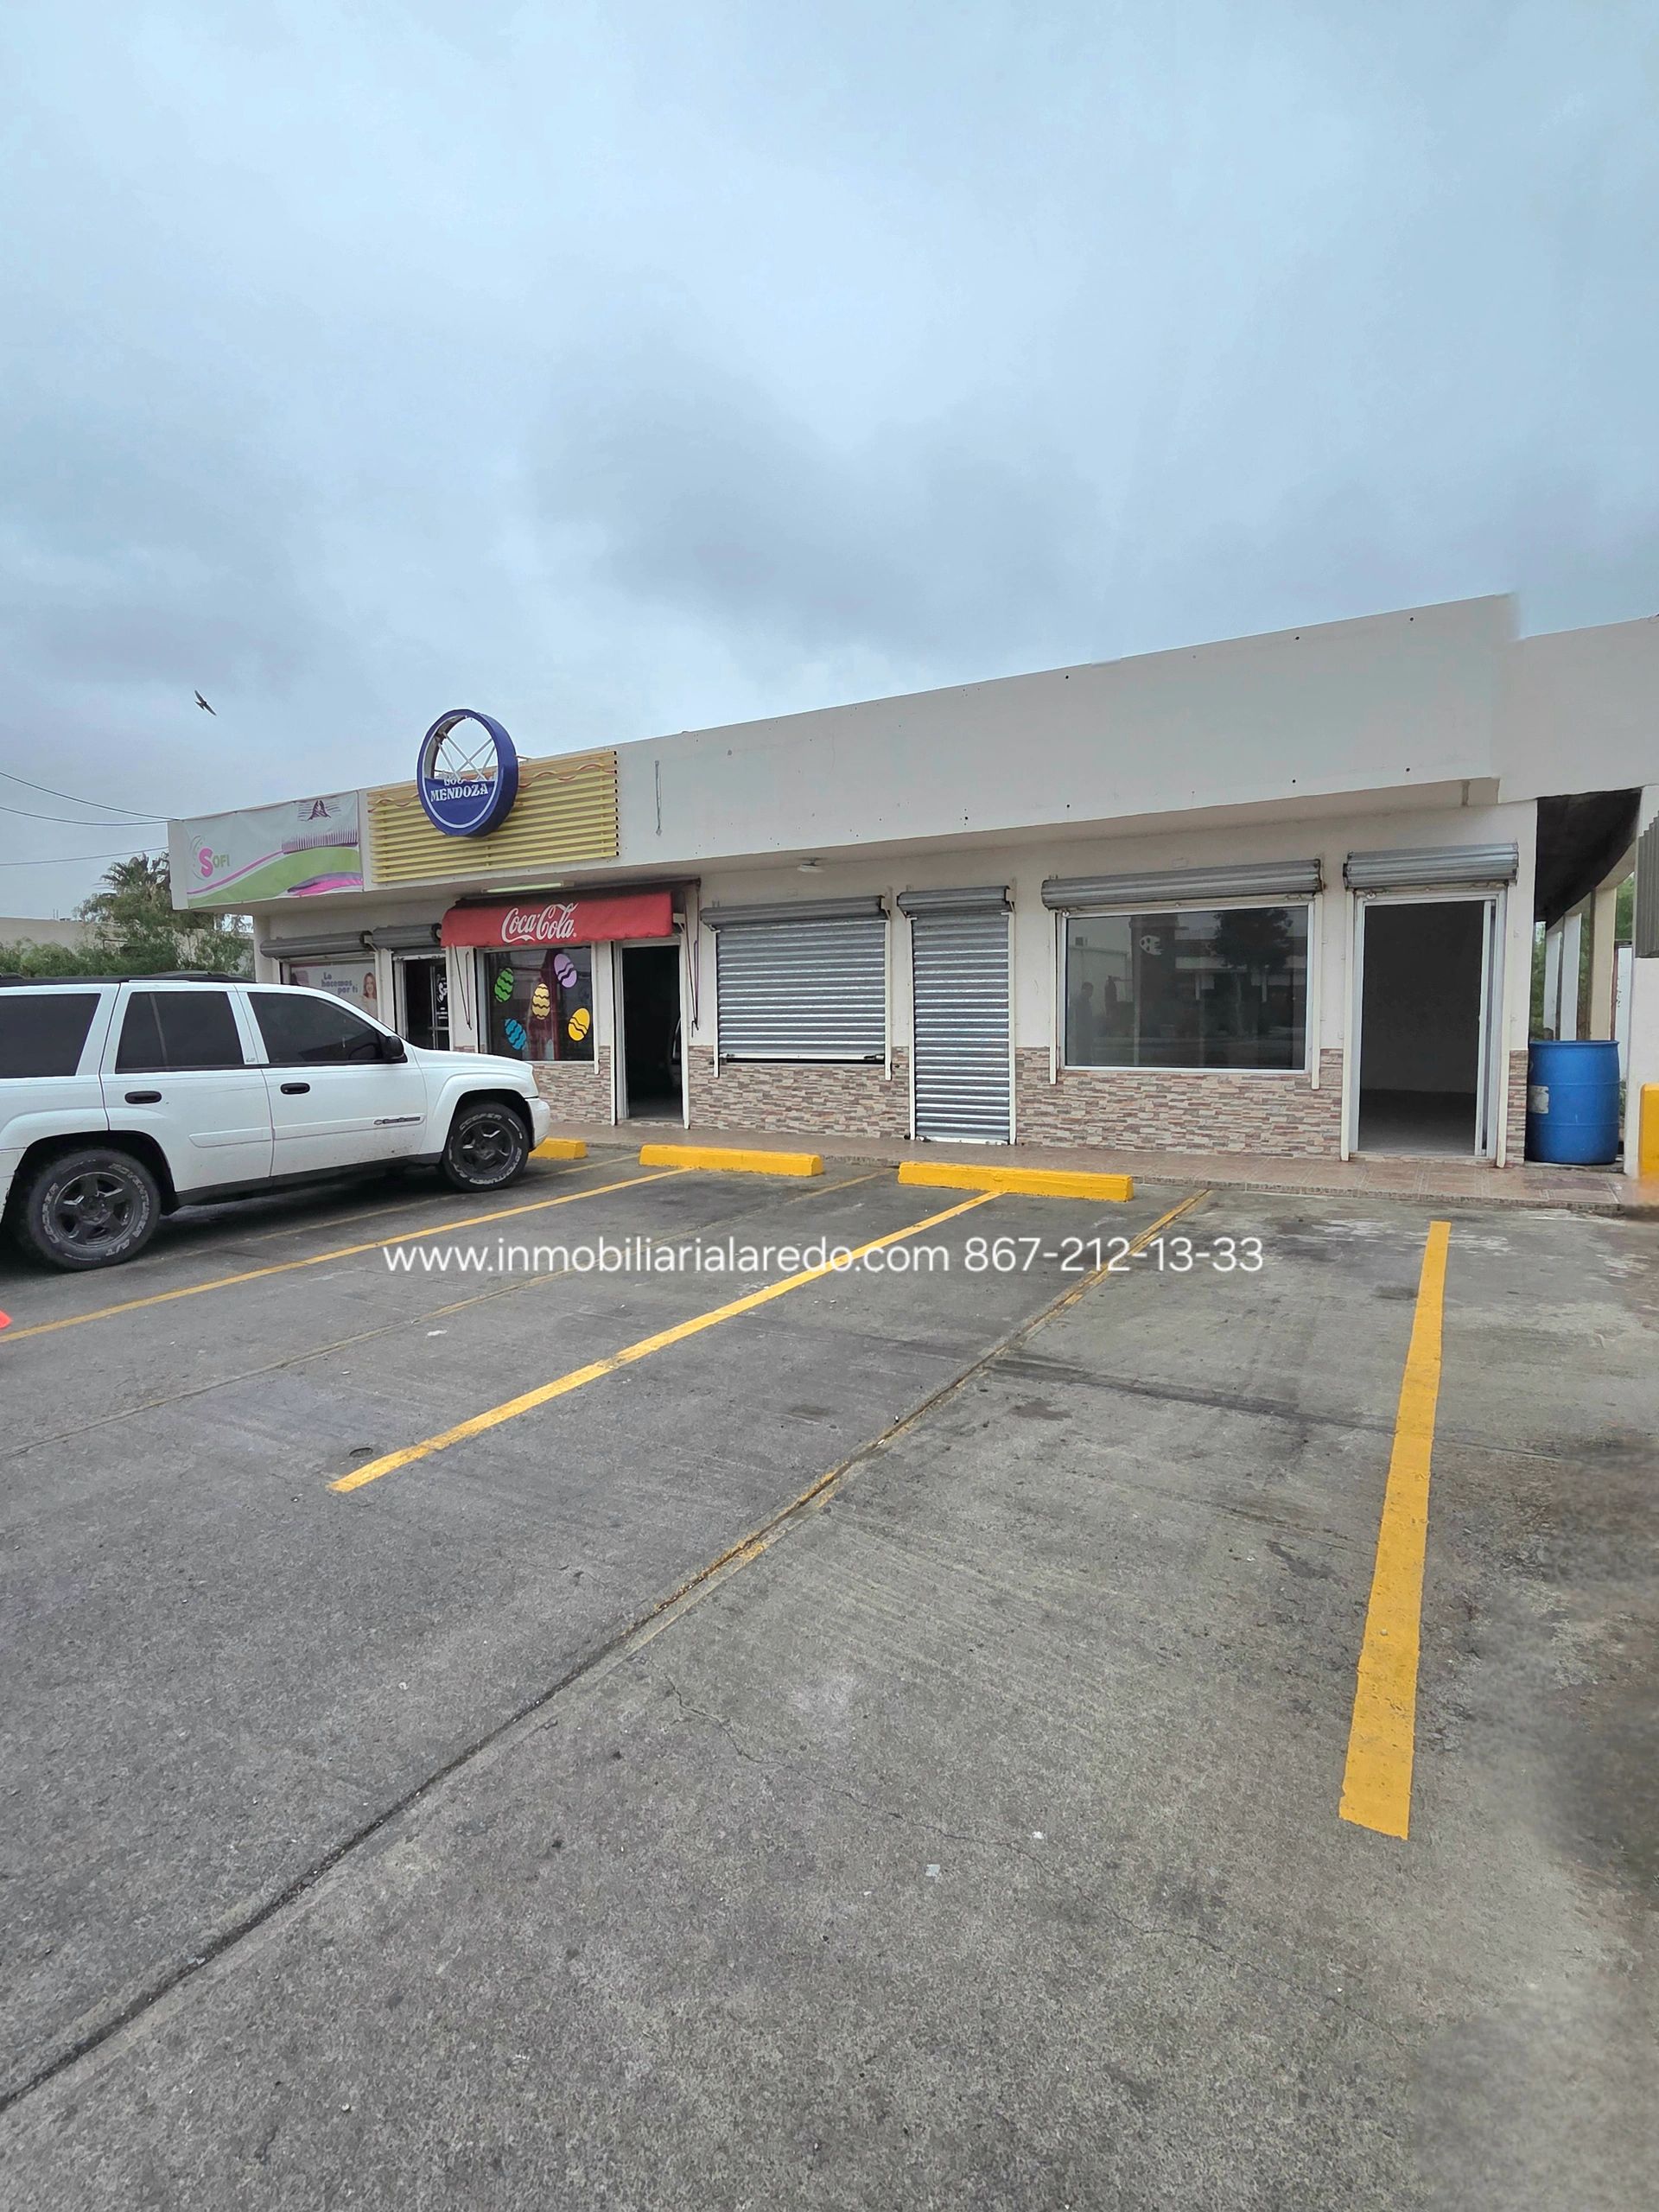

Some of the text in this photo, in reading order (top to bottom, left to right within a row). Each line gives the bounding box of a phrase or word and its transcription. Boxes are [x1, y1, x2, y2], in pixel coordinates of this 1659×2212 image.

[430, 783, 488, 802] MENDOZA
[199, 847, 231, 877] SOFI
[501, 902, 579, 944] Coca-Cola
